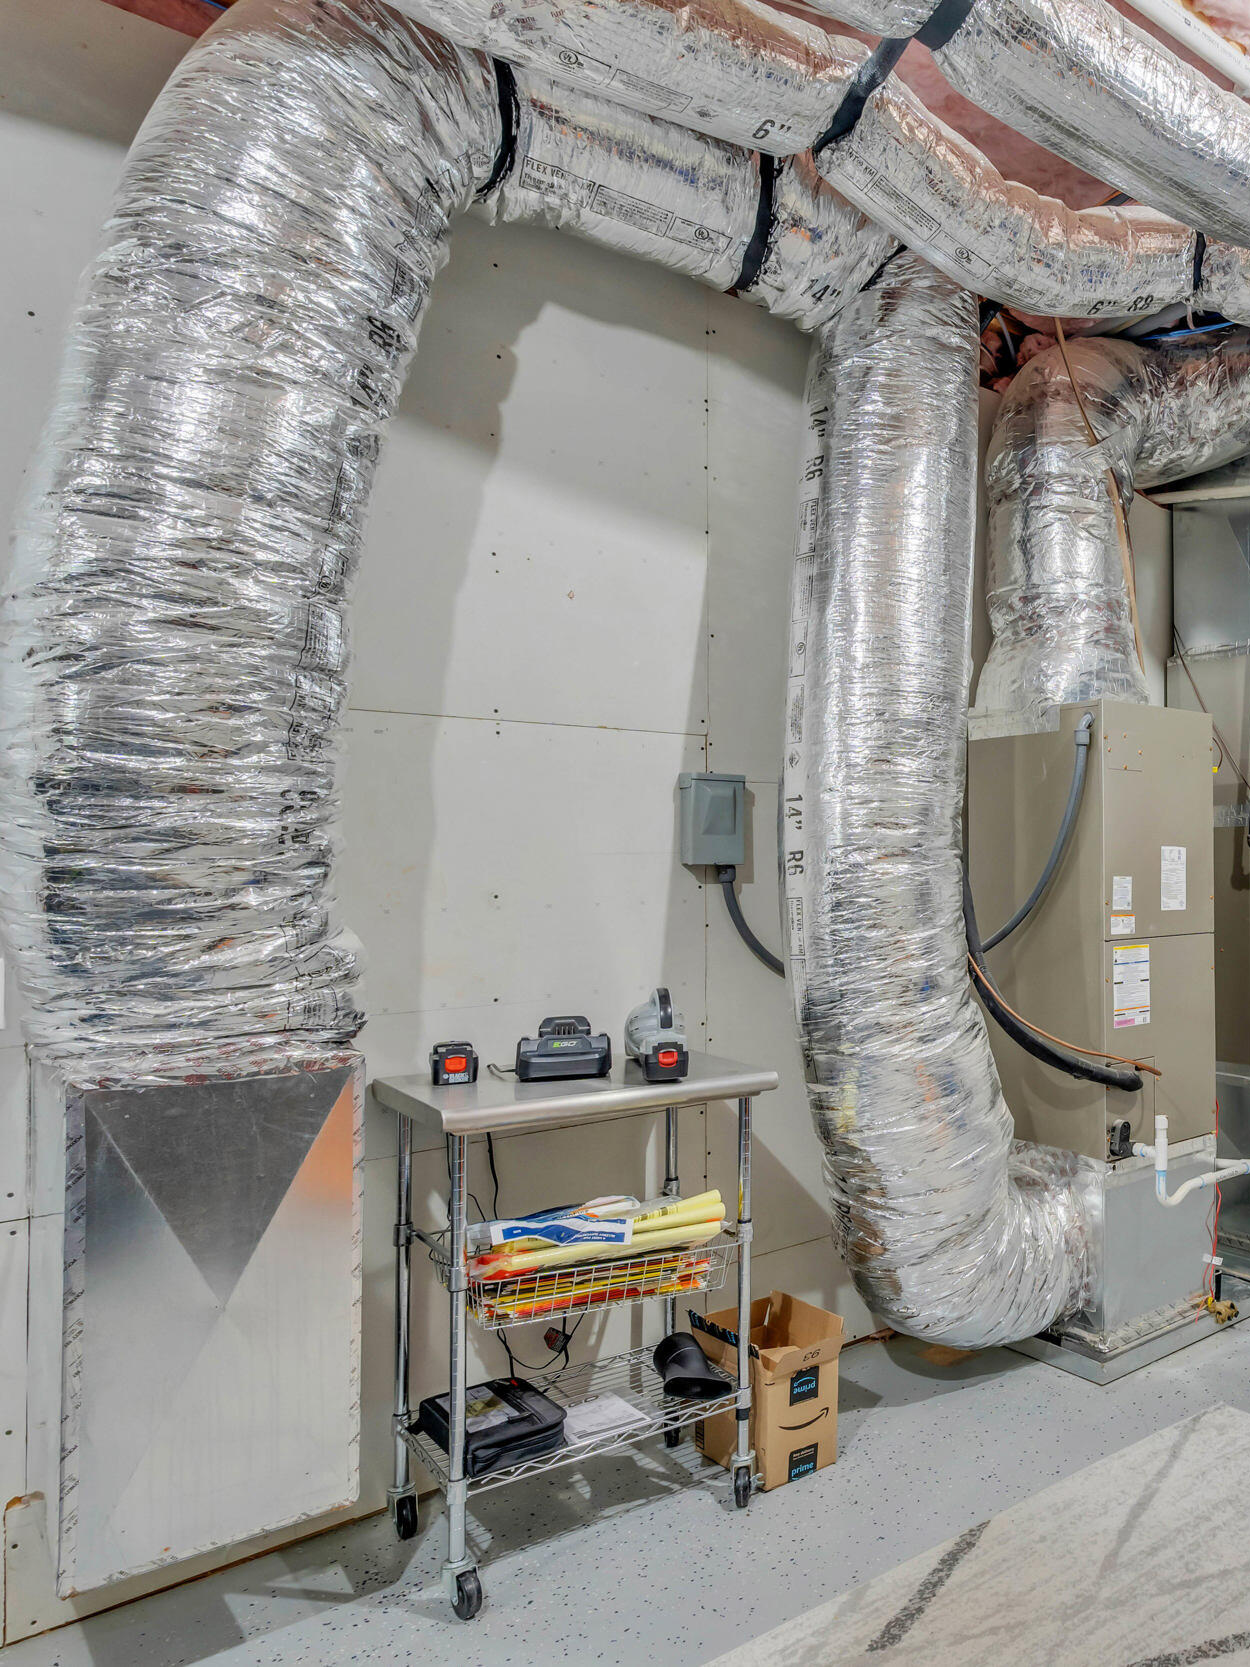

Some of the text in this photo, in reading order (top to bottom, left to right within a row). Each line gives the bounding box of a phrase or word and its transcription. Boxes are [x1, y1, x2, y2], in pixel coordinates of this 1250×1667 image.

[752, 118, 792, 140] 6"
[526, 160, 548, 175] FLEX
[805, 455, 824, 482] R6
[786, 794, 804, 876] 14" R6
[793, 1380, 816, 1394] prime
[791, 1462, 815, 1478] prime
